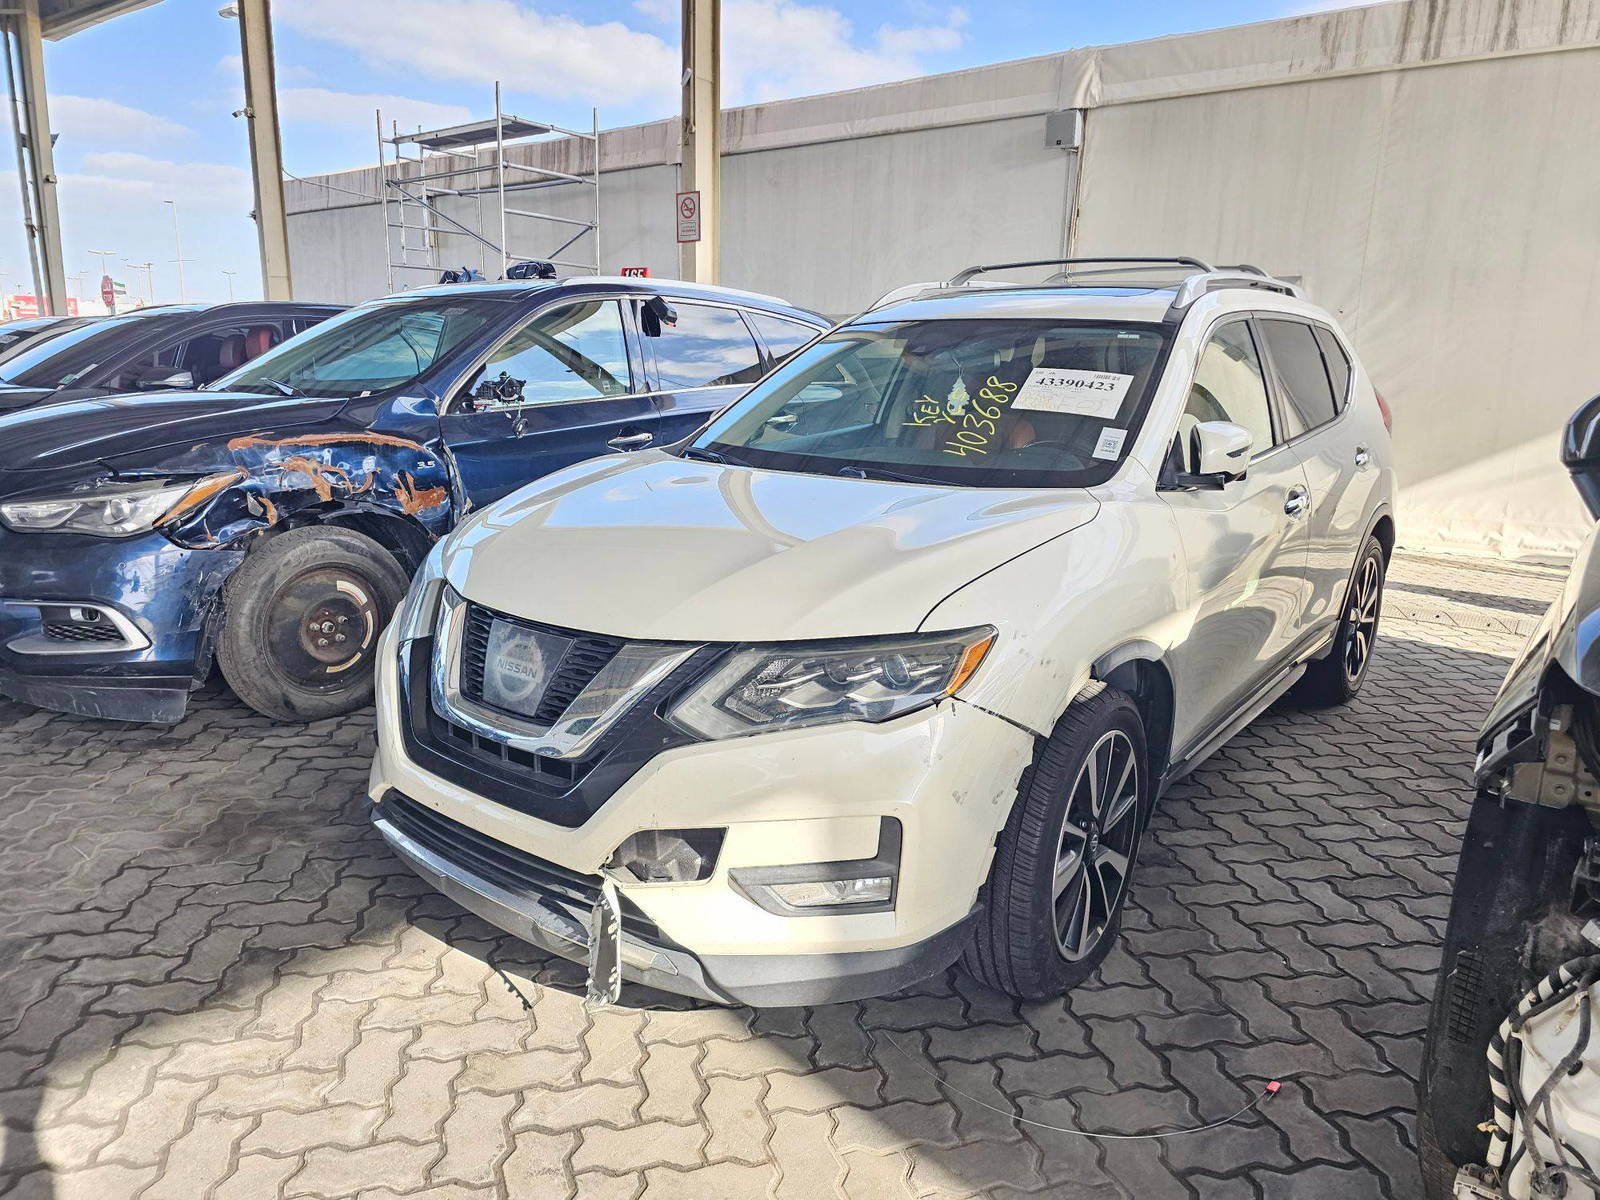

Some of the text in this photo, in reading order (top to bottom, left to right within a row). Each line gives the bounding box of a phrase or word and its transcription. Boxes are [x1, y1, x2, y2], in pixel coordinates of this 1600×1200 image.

[1035, 377, 1115, 391] 43390423
[901, 395, 940, 426] KEY
[943, 375, 1018, 456] 403688
[497, 657, 538, 679] NISSAN
